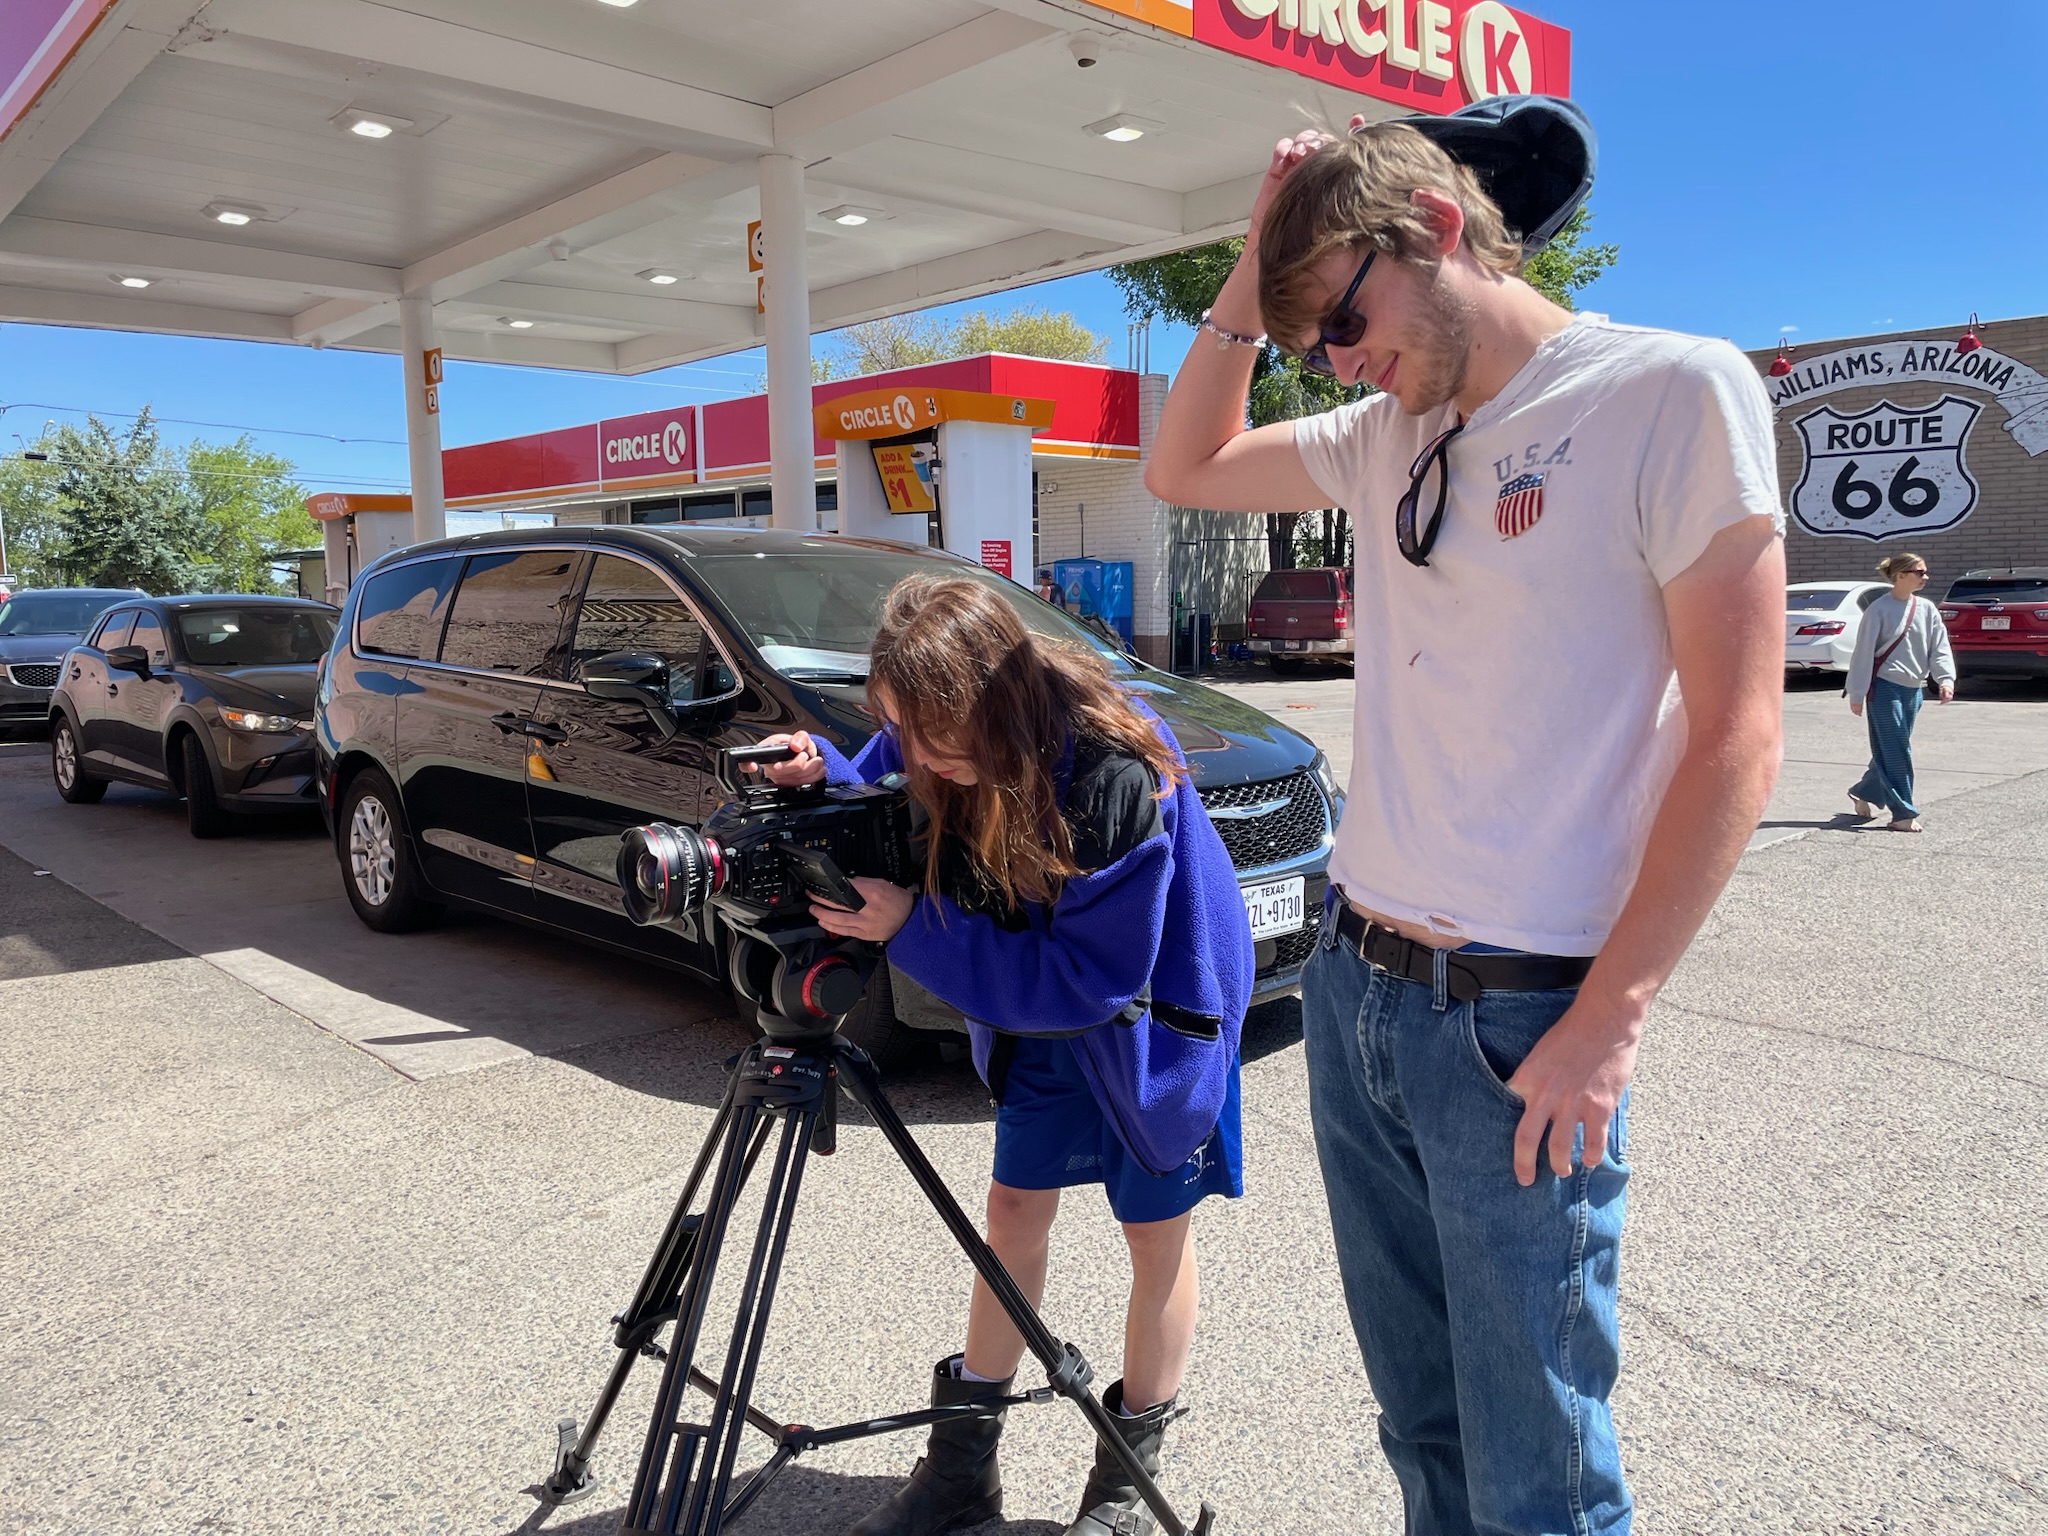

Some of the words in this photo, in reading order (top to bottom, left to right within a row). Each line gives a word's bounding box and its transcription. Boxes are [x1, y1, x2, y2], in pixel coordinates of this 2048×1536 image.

[1231, 0, 1453, 81] RCLE
[1768, 351, 1894, 406] WILLIAMS,
[1901, 346, 2015, 391] ARIZONA
[840, 405, 892, 431] CIRCLE
[1827, 415, 1944, 450] ROUTE
[606, 432, 660, 464] CIRCLE
[880, 452, 897, 463] ADD
[897, 452, 904, 462] A
[1493, 437, 1573, 482] U.S.A.
[888, 478, 913, 508] $1
[1832, 455, 1941, 520] 66
[1260, 883, 1286, 898] TEXAS
